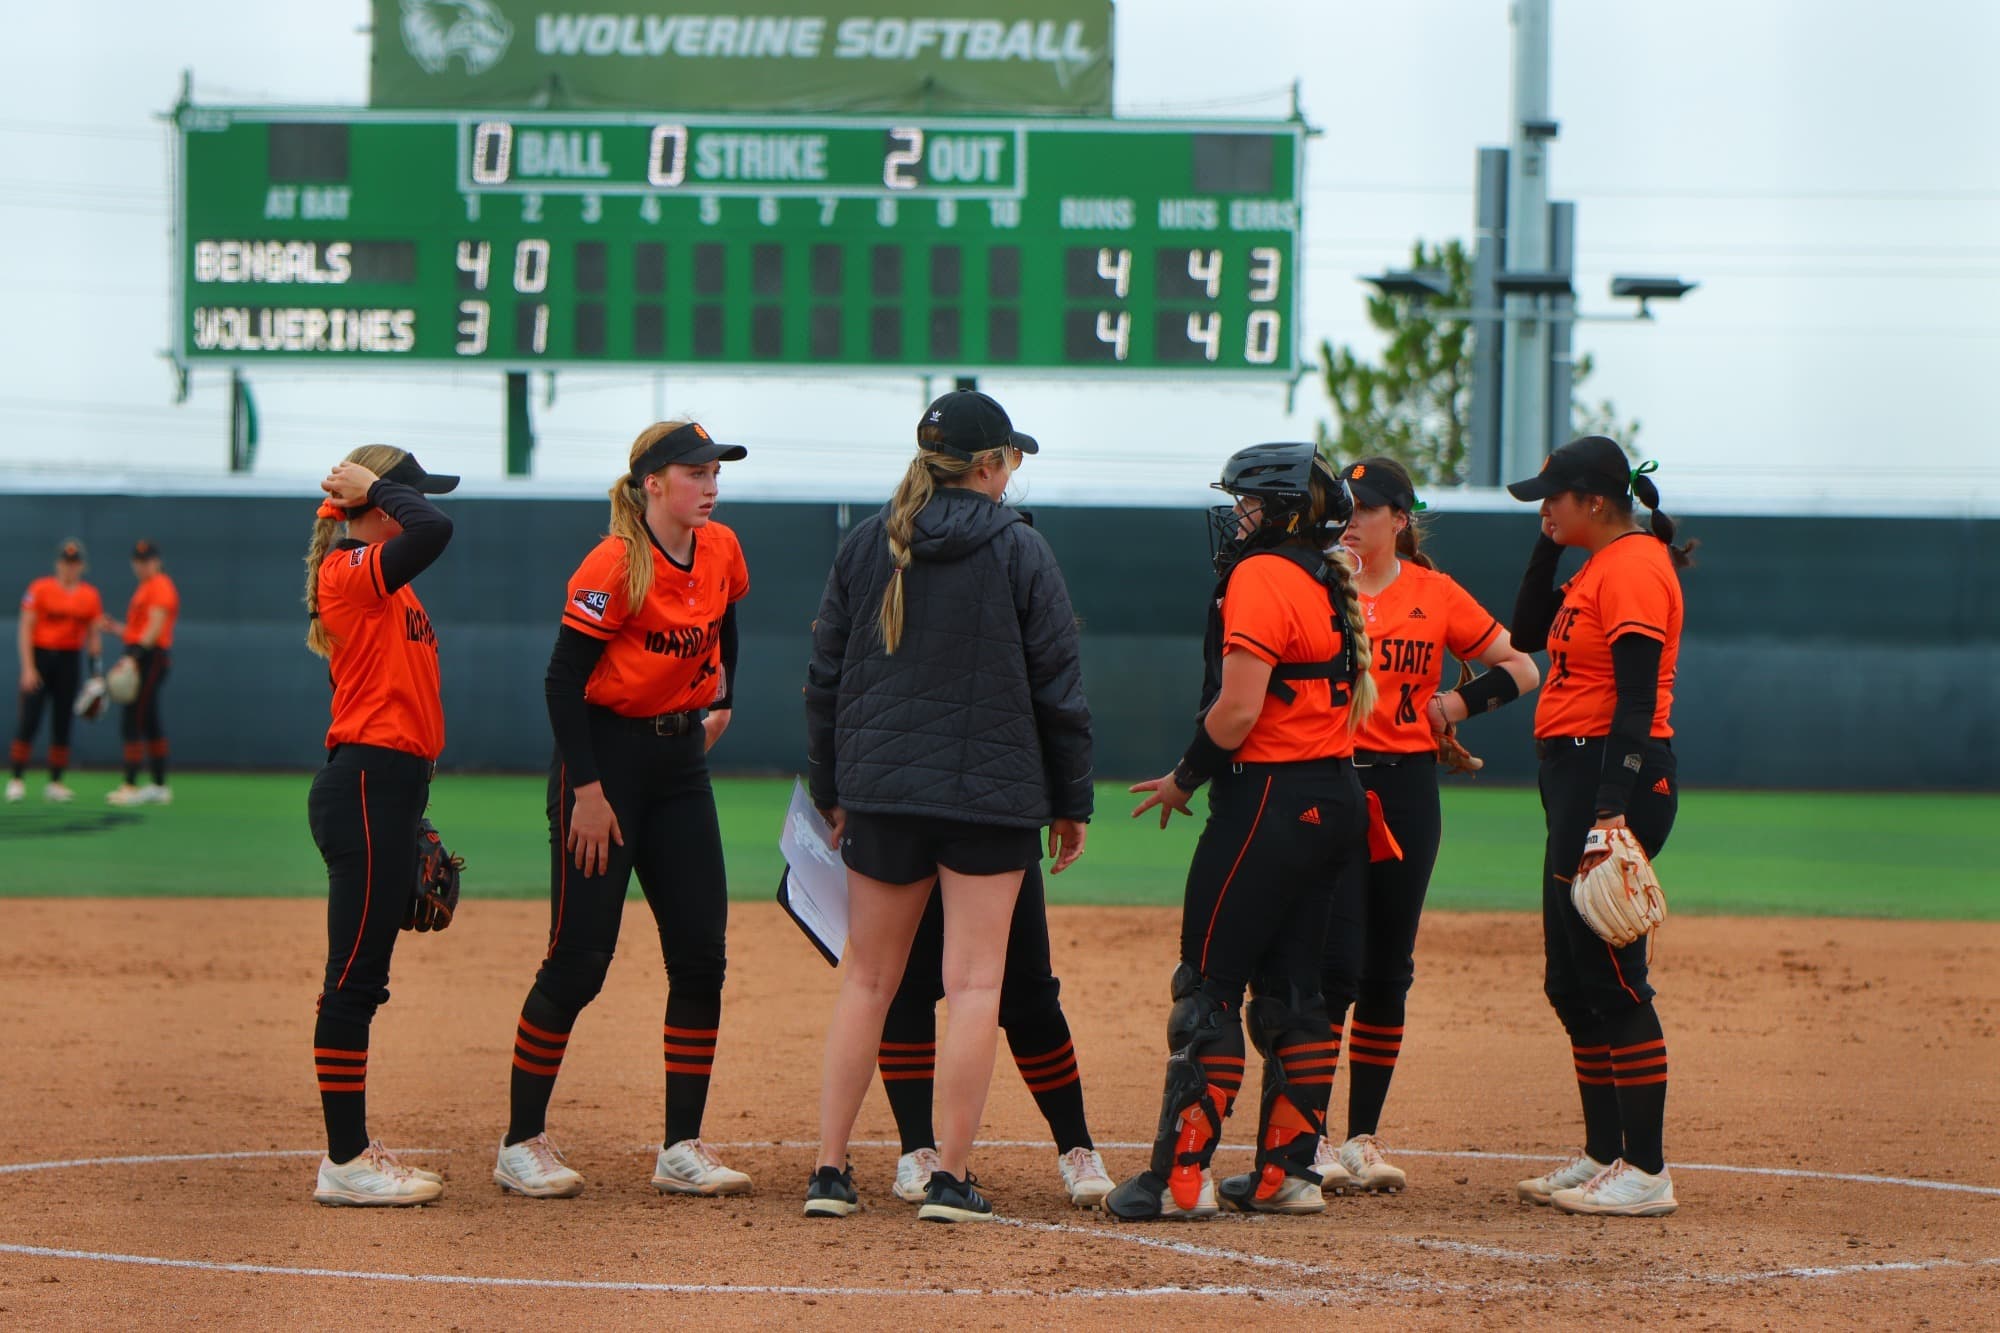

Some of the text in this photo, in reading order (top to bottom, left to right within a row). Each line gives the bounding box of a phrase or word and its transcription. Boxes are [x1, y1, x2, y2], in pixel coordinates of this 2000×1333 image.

[535, 14, 1092, 62] WOLVERINE SOFTBALL
[473, 121, 512, 184] 0
[518, 131, 610, 177] BALL
[648, 124, 687, 187] 0
[696, 134, 829, 181] STRIKE
[884, 127, 923, 190] 2
[929, 138, 1006, 182] OUT
[265, 187, 350, 219] AT BAT
[465, 195, 1020, 227] 1 2 3 4 5 6 7 8 9 10
[1060, 198, 1134, 229] RUNS
[1158, 200, 1218, 229] HITS
[1229, 200, 1297, 229] ERRS
[194, 240, 351, 283] BENGALS
[457, 239, 549, 293] 4 0
[1097, 248, 1131, 298] 4
[1187, 249, 1221, 298] 4
[1249, 247, 1280, 301] 3
[456, 300, 549, 355] 3 1
[1096, 311, 1130, 361] 4
[1187, 311, 1221, 361] 4
[1244, 309, 1280, 364] 0
[587, 592, 609, 609] SKY
[1379, 638, 1434, 675] STATE
